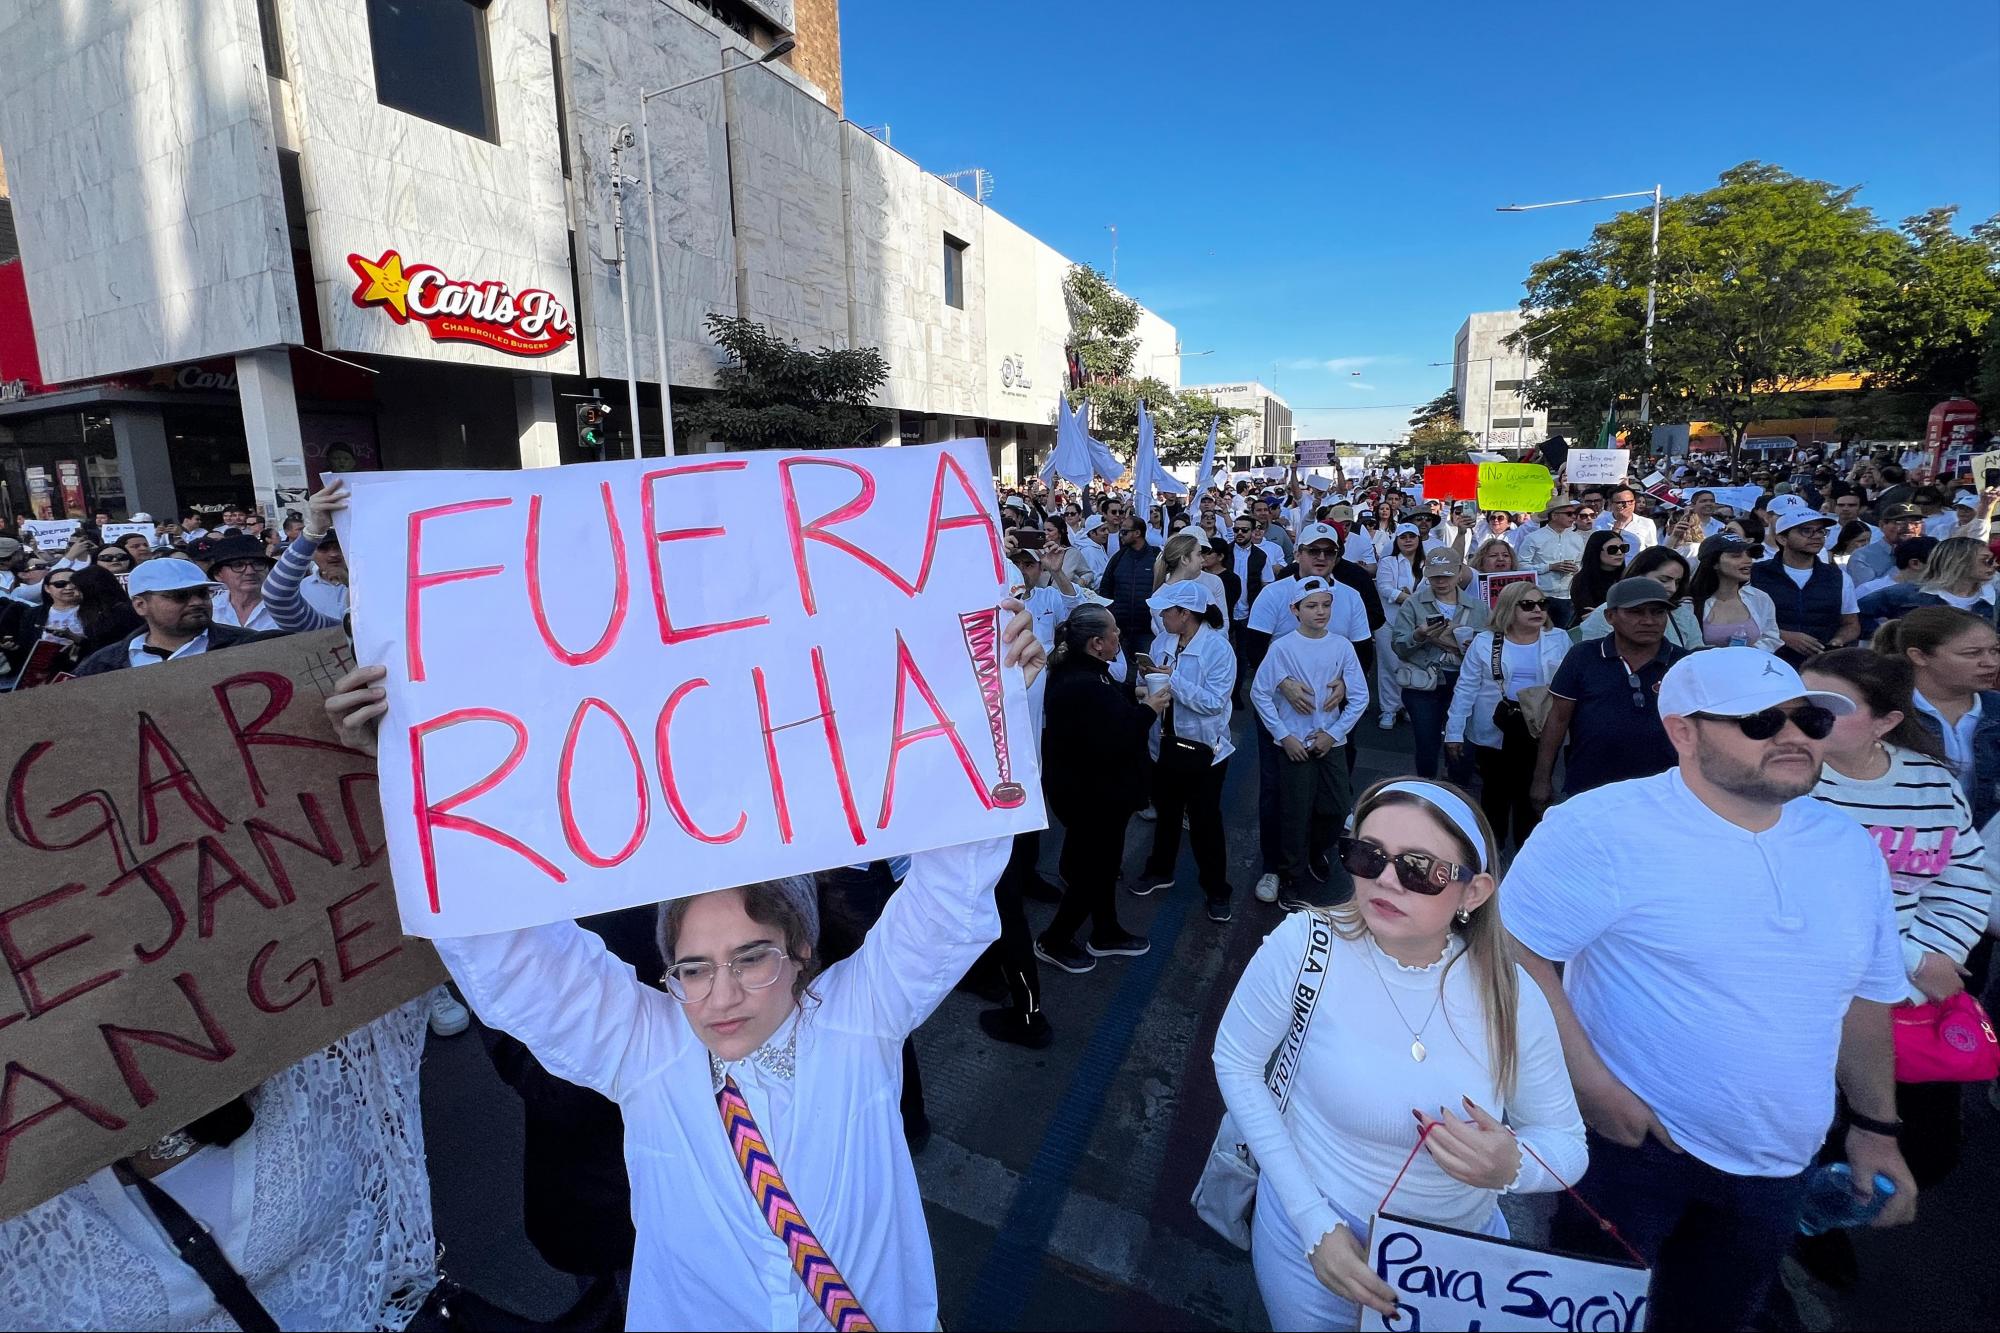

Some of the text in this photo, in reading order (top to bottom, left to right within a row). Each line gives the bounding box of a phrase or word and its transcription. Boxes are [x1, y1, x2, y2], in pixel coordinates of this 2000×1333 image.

[407, 269, 519, 324] Carl's
[406, 451, 1005, 683] FUERA
[408, 606, 1026, 914] ROCHA!
[1377, 1231, 1487, 1310] Para
